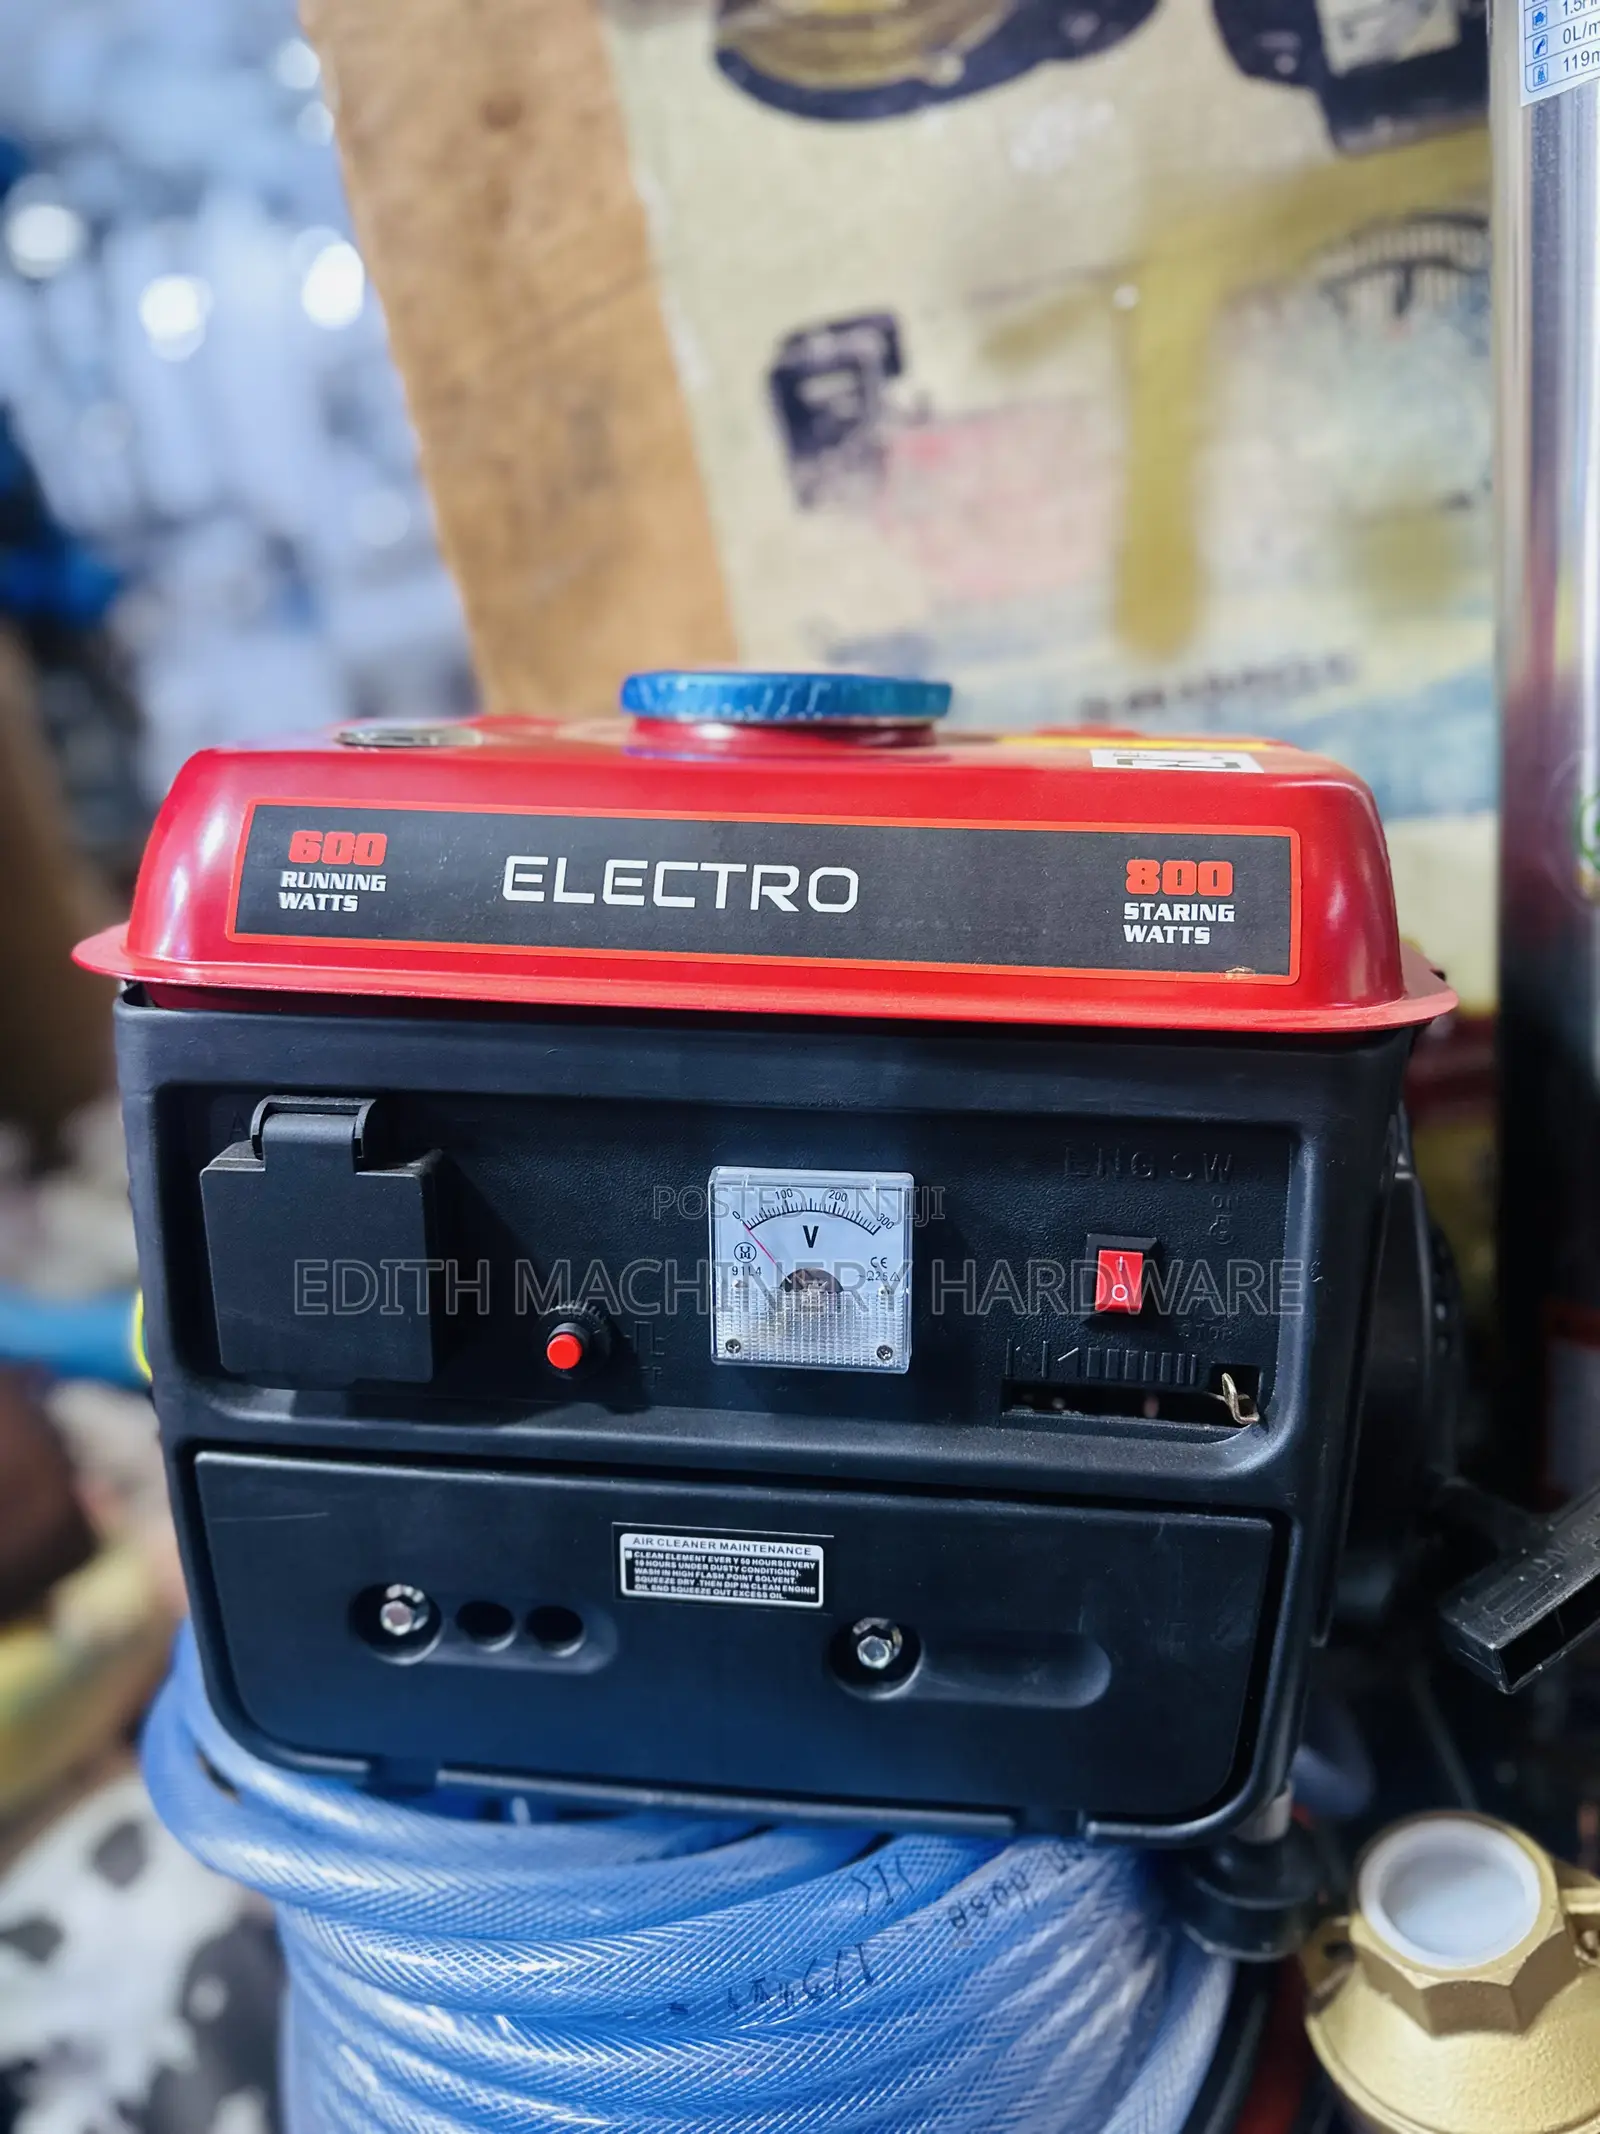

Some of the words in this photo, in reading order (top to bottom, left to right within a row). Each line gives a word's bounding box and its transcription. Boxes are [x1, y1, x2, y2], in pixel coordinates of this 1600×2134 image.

[288, 830, 388, 867] 600
[280, 870, 387, 892] RUNNING
[502, 855, 859, 914] ELECTRO
[1125, 859, 1234, 897] 800
[278, 891, 359, 912] WATTS
[1123, 902, 1236, 922] STARING
[1122, 924, 1211, 945] WATTS
[775, 1188, 794, 1201] 100
[828, 1189, 848, 1202] 200
[732, 1210, 741, 1220] 0
[876, 1213, 895, 1231] 300
[802, 1225, 819, 1249] V
[731, 1265, 762, 1277] 91L4
[632, 1537, 654, 1547] AIR
[657, 1538, 716, 1550] CLEANER
[719, 1541, 812, 1556] MAINTENANCE
[633, 1551, 664, 1561] CLEAN
[665, 1552, 707, 1563] ELEMENT
[633, 1567, 660, 1577] WASH
[661, 1569, 671, 1577] IN
[672, 1570, 694, 1579] HIGH
[645, 1560, 677, 1569] HOURS
[678, 1562, 709, 1571] UNDER
[710, 1564, 740, 1573] DUSTY
[676, 1577, 696, 1586] DRY
[723, 1581, 740, 1589] DIP
[740, 1582, 750, 1590] IN
[750, 1582, 781, 1592] CLEAN
[781, 1585, 816, 1595] ENGINE
[712, 1588, 732, 1597] OUT
[732, 1589, 768, 1599] EXCESS
